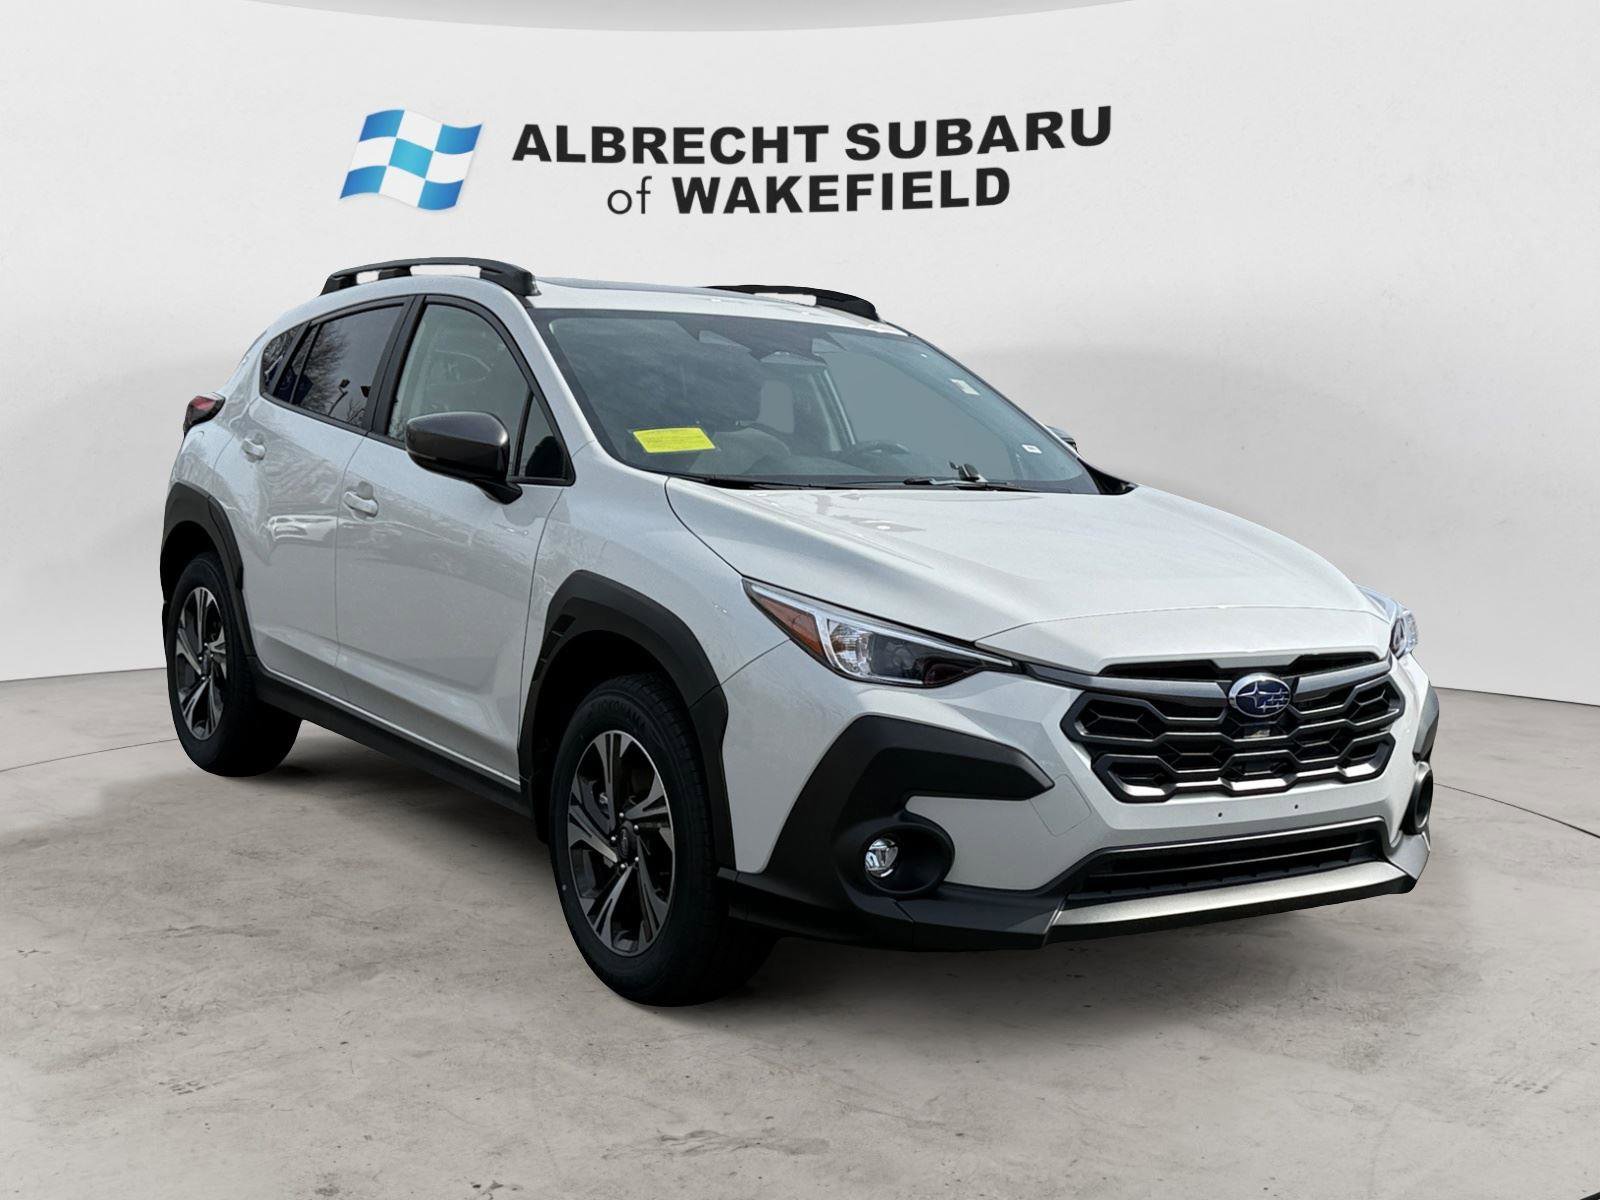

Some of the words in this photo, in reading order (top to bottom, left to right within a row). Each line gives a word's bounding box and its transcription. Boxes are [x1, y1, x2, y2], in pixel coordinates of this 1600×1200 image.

[512, 124, 829, 165] ALBRECHT
[845, 106, 1112, 161] SUBARU
[607, 175, 653, 215] of
[671, 168, 1010, 214] WAKEFIELD
